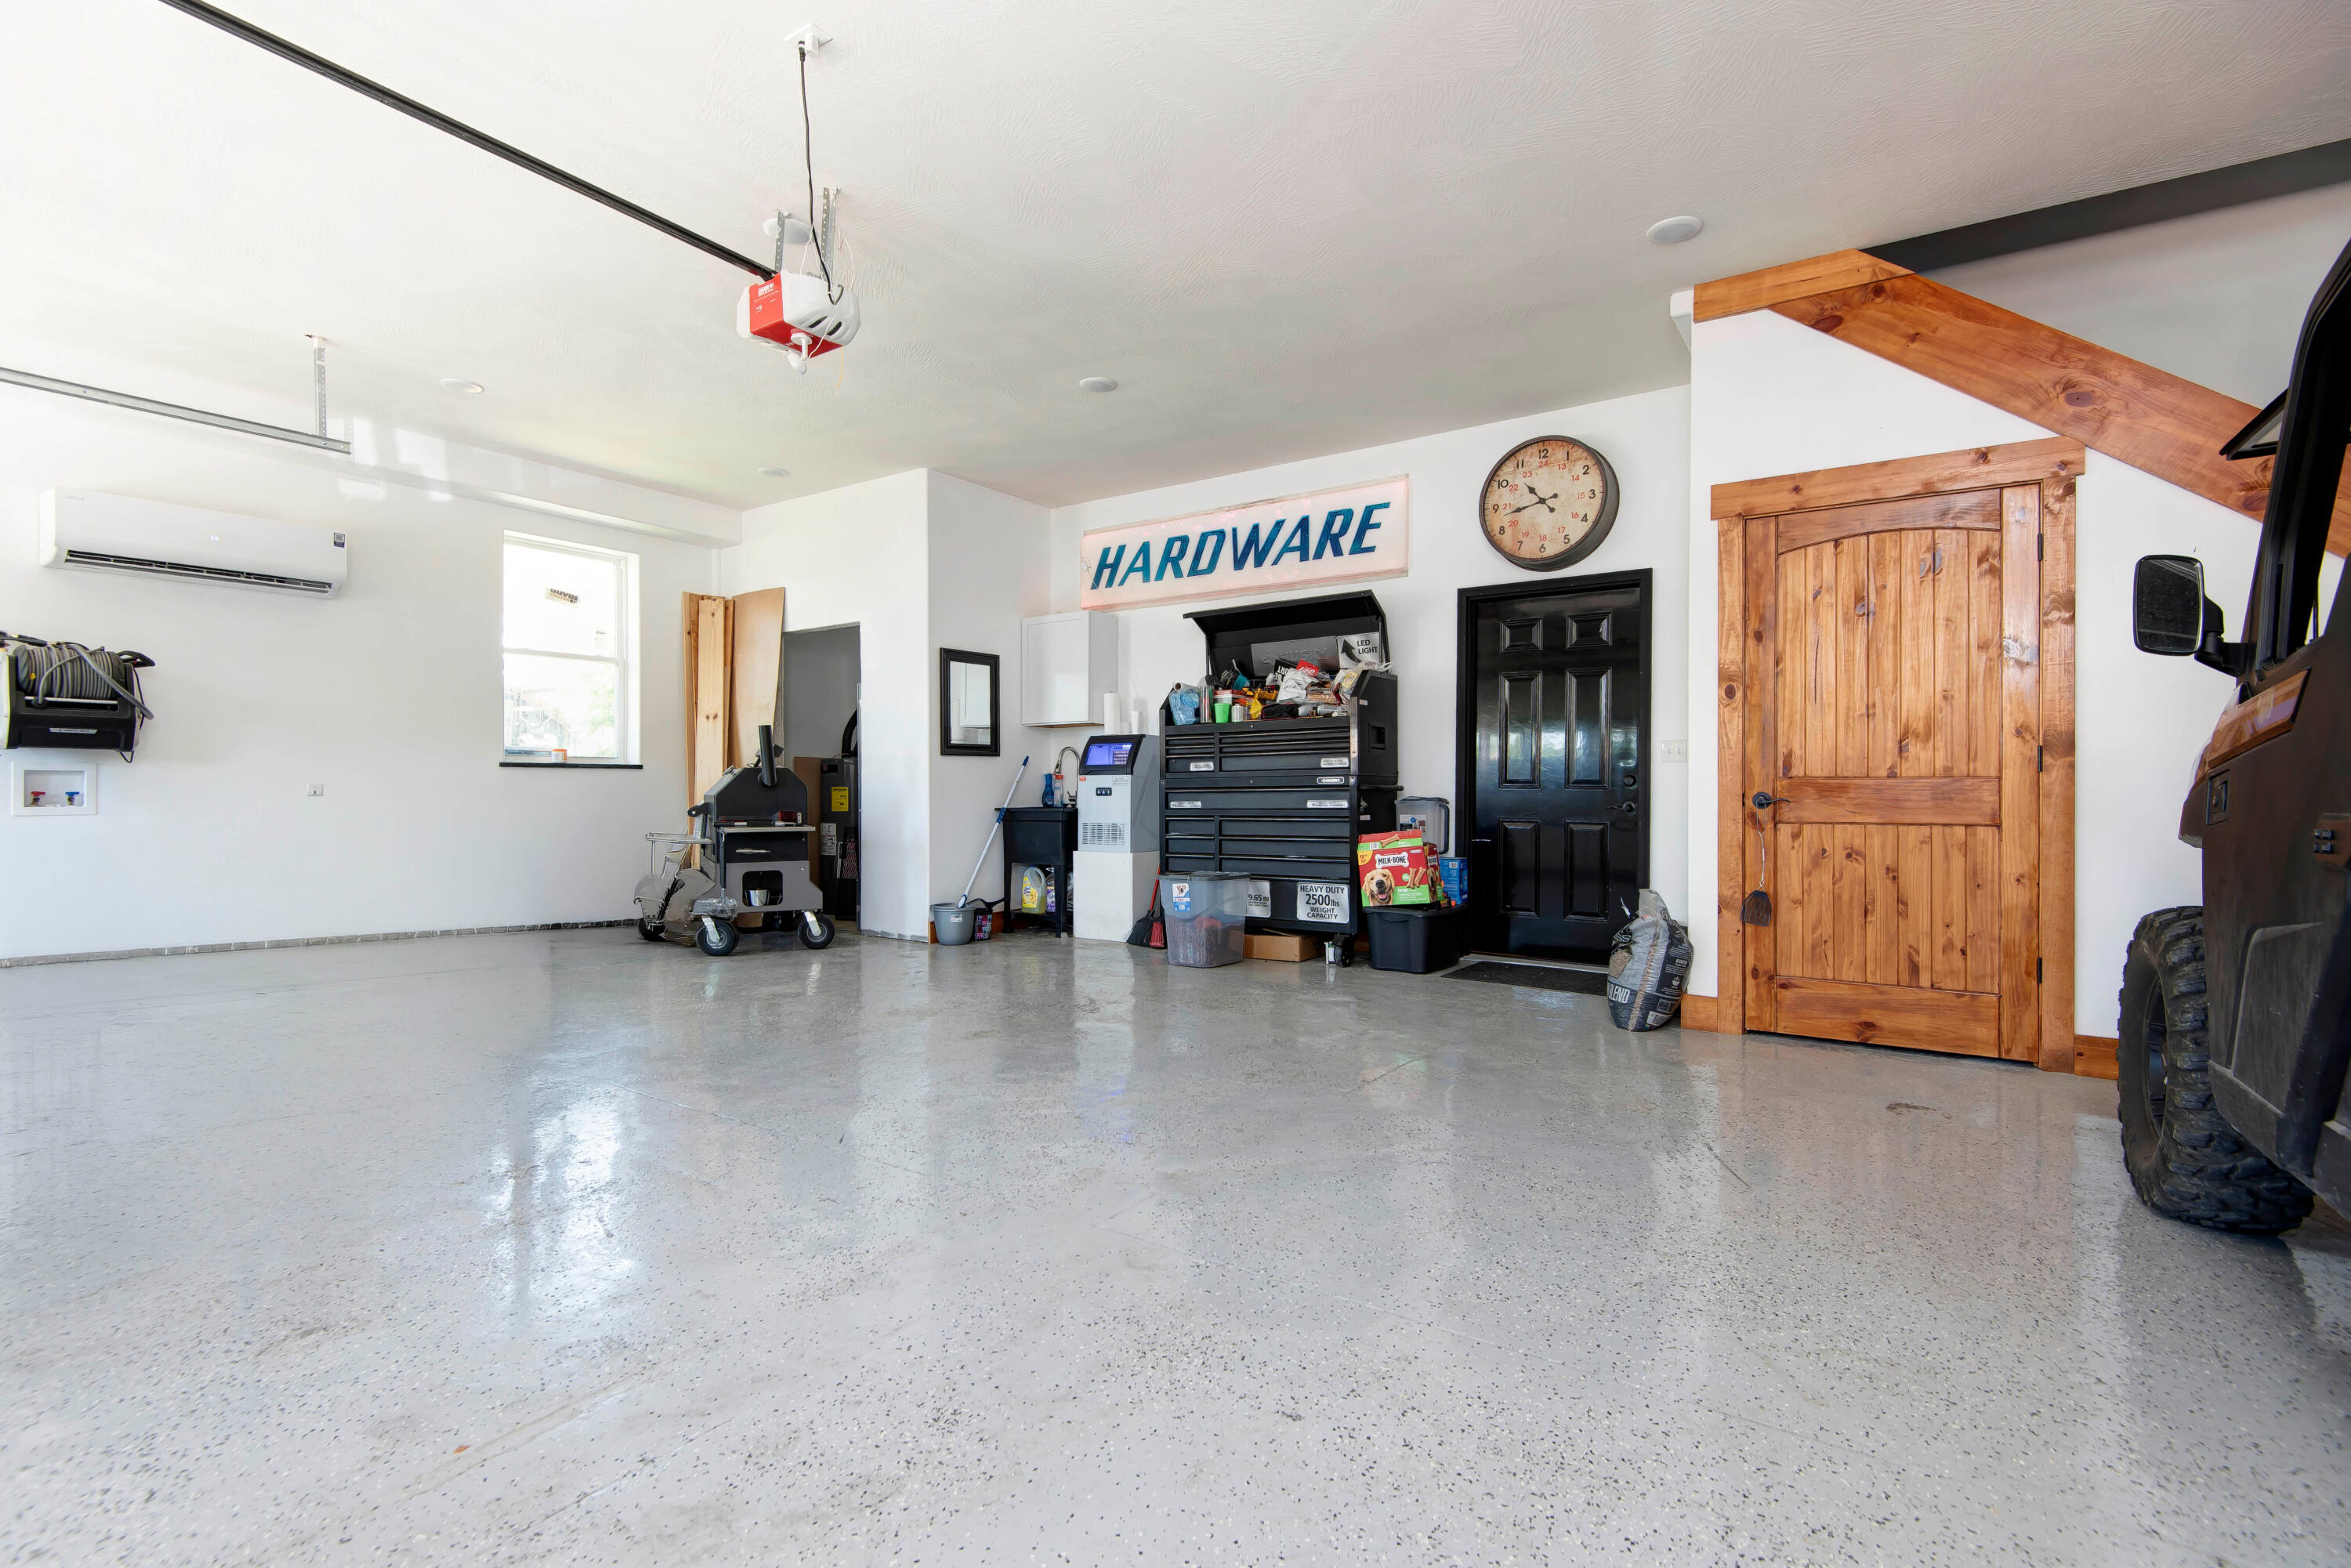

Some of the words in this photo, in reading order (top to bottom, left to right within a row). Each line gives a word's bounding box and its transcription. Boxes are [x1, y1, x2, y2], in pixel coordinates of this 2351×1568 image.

[1538, 448, 1549, 460] 12
[1567, 451, 1570, 462] 1
[1516, 458, 1524, 469] 11
[1538, 460, 1549, 469] 24
[1523, 470, 1533, 479] 23
[1582, 464, 1589, 475] 2
[1498, 479, 1509, 490] 10
[1509, 483, 1519, 492] 22
[1577, 491, 1585, 500] 15
[1588, 489, 1596, 499] 3
[1492, 503, 1500, 514] 9
[1581, 512, 1588, 523] 4
[1498, 525, 1505, 535] 8
[1563, 534, 1570, 545] 5
[1090, 502, 1391, 590] HARDWARE
[1517, 541, 1523, 551] 7
[1538, 543, 1546, 553] 6
[1306, 893, 1330, 906] 2500
